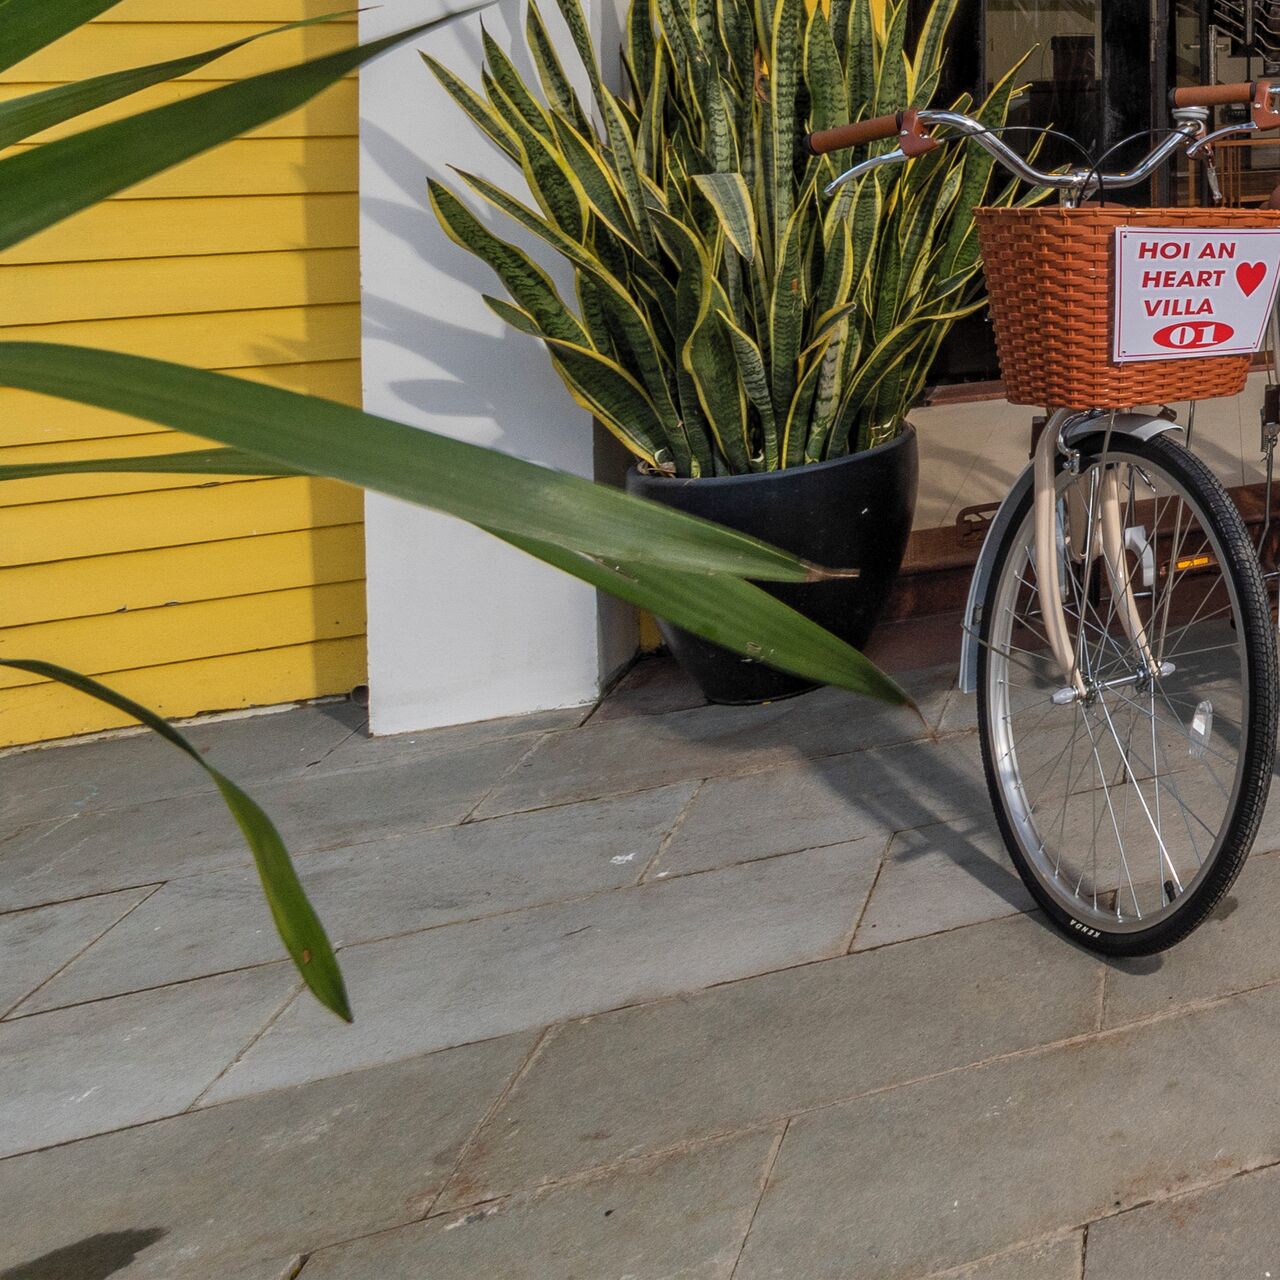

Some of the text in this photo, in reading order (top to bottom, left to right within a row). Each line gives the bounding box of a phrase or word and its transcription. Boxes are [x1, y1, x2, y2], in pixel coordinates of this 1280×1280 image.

[1138, 242, 1236, 259] HOI AN
[1142, 270, 1226, 288] HEART
[1144, 298, 1213, 317] VILLA
[1169, 324, 1218, 346] 01
[1070, 919, 1101, 938] KENDA
